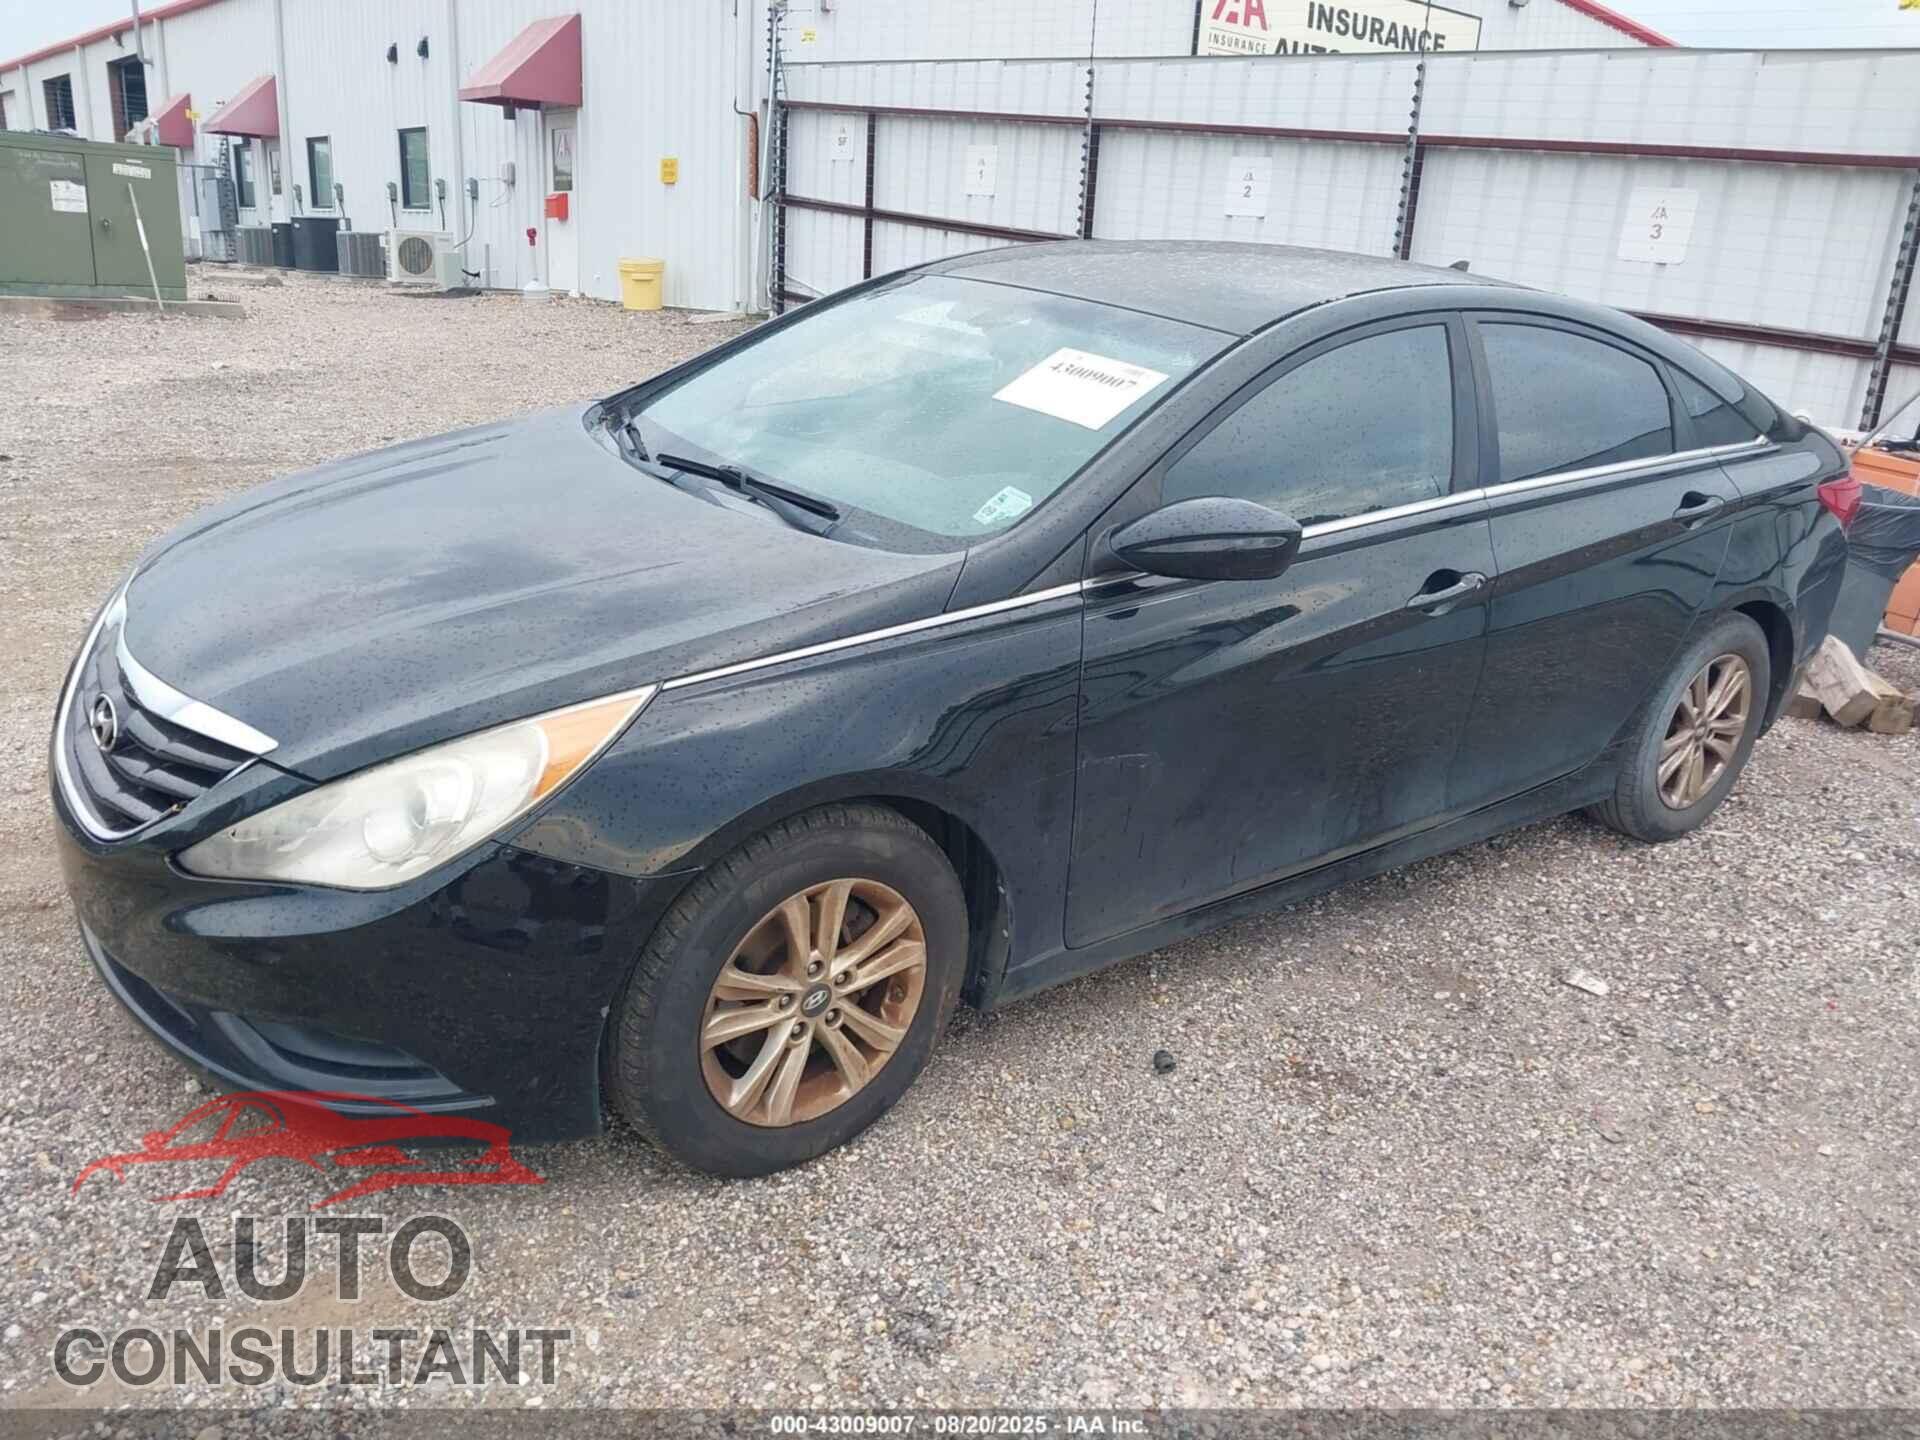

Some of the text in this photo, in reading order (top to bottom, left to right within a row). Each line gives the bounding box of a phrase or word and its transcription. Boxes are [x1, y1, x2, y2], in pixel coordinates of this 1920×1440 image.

[1307, 1, 1446, 51] INSURANCE
[1208, 32, 1267, 54] INSURANCE
[1243, 185, 1252, 198] 2
[1649, 223, 1663, 240] 3
